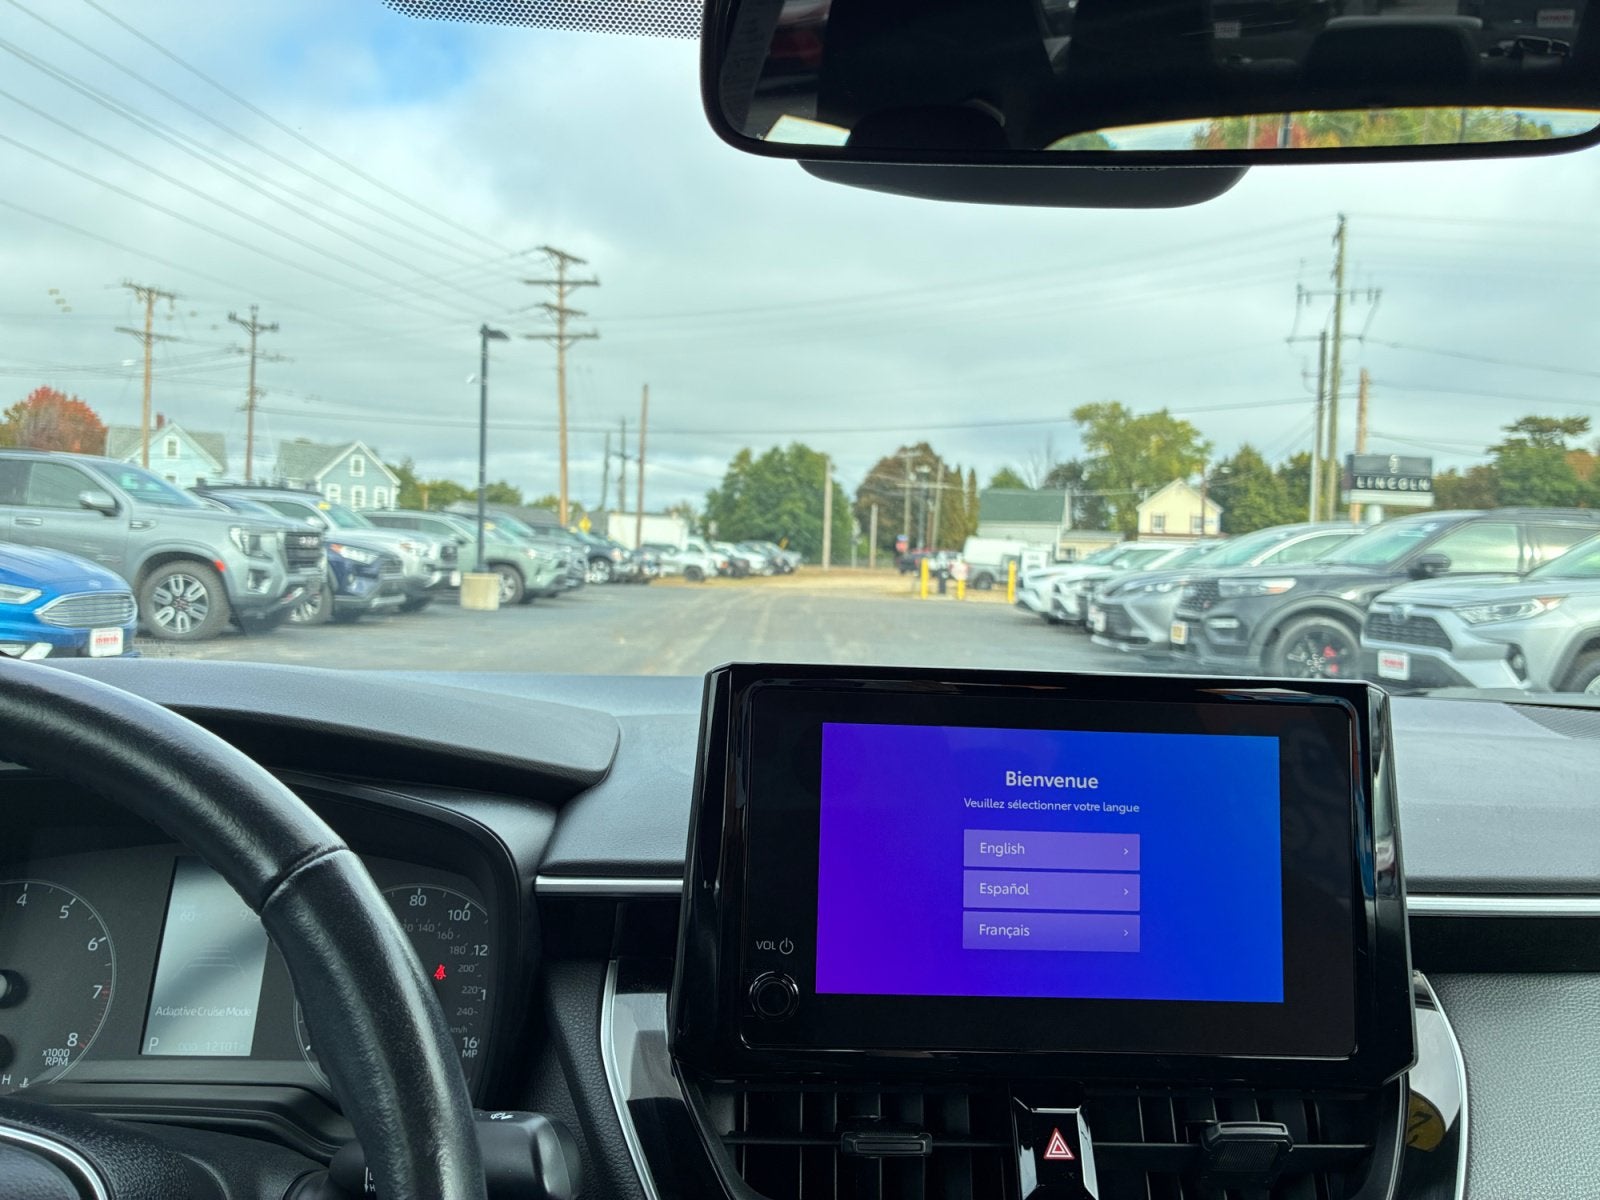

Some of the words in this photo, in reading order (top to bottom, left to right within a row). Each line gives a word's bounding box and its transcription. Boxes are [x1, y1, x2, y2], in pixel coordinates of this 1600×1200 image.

[1356, 476, 1431, 491] LINCOLN
[1005, 771, 1099, 789] Bienvenue
[964, 798, 1005, 809] Veuillez
[1007, 799, 1072, 811] sélectionner
[1073, 802, 1101, 812] votre
[1102, 802, 1140, 815] langue
[980, 842, 1025, 857] English
[979, 883, 1030, 897] Español
[16, 893, 28, 907] 4
[409, 894, 427, 907] 80
[59, 905, 71, 919] 5
[447, 909, 471, 921] 100
[418, 923, 435, 933] 140
[979, 924, 1031, 939] Français
[437, 931, 454, 940] 160
[87, 937, 98, 951] 6
[473, 944, 489, 956] 12
[755, 940, 777, 950] VOL
[449, 946, 466, 955] 180
[458, 964, 475, 973] 200
[93, 985, 103, 999] 7
[462, 985, 478, 994] 220
[154, 1006, 198, 1018] Adaptive
[197, 1006, 226, 1017] Cruise
[225, 1007, 252, 1017] Mode
[456, 1007, 474, 1016] 240
[67, 1032, 79, 1047] 8
[148, 1036, 159, 1052] P
[462, 1036, 480, 1049] 16
[42, 1048, 71, 1058] x1000
[462, 1049, 478, 1058] MP
[45, 1057, 69, 1066] RPM
[1, 1074, 12, 1085] H
